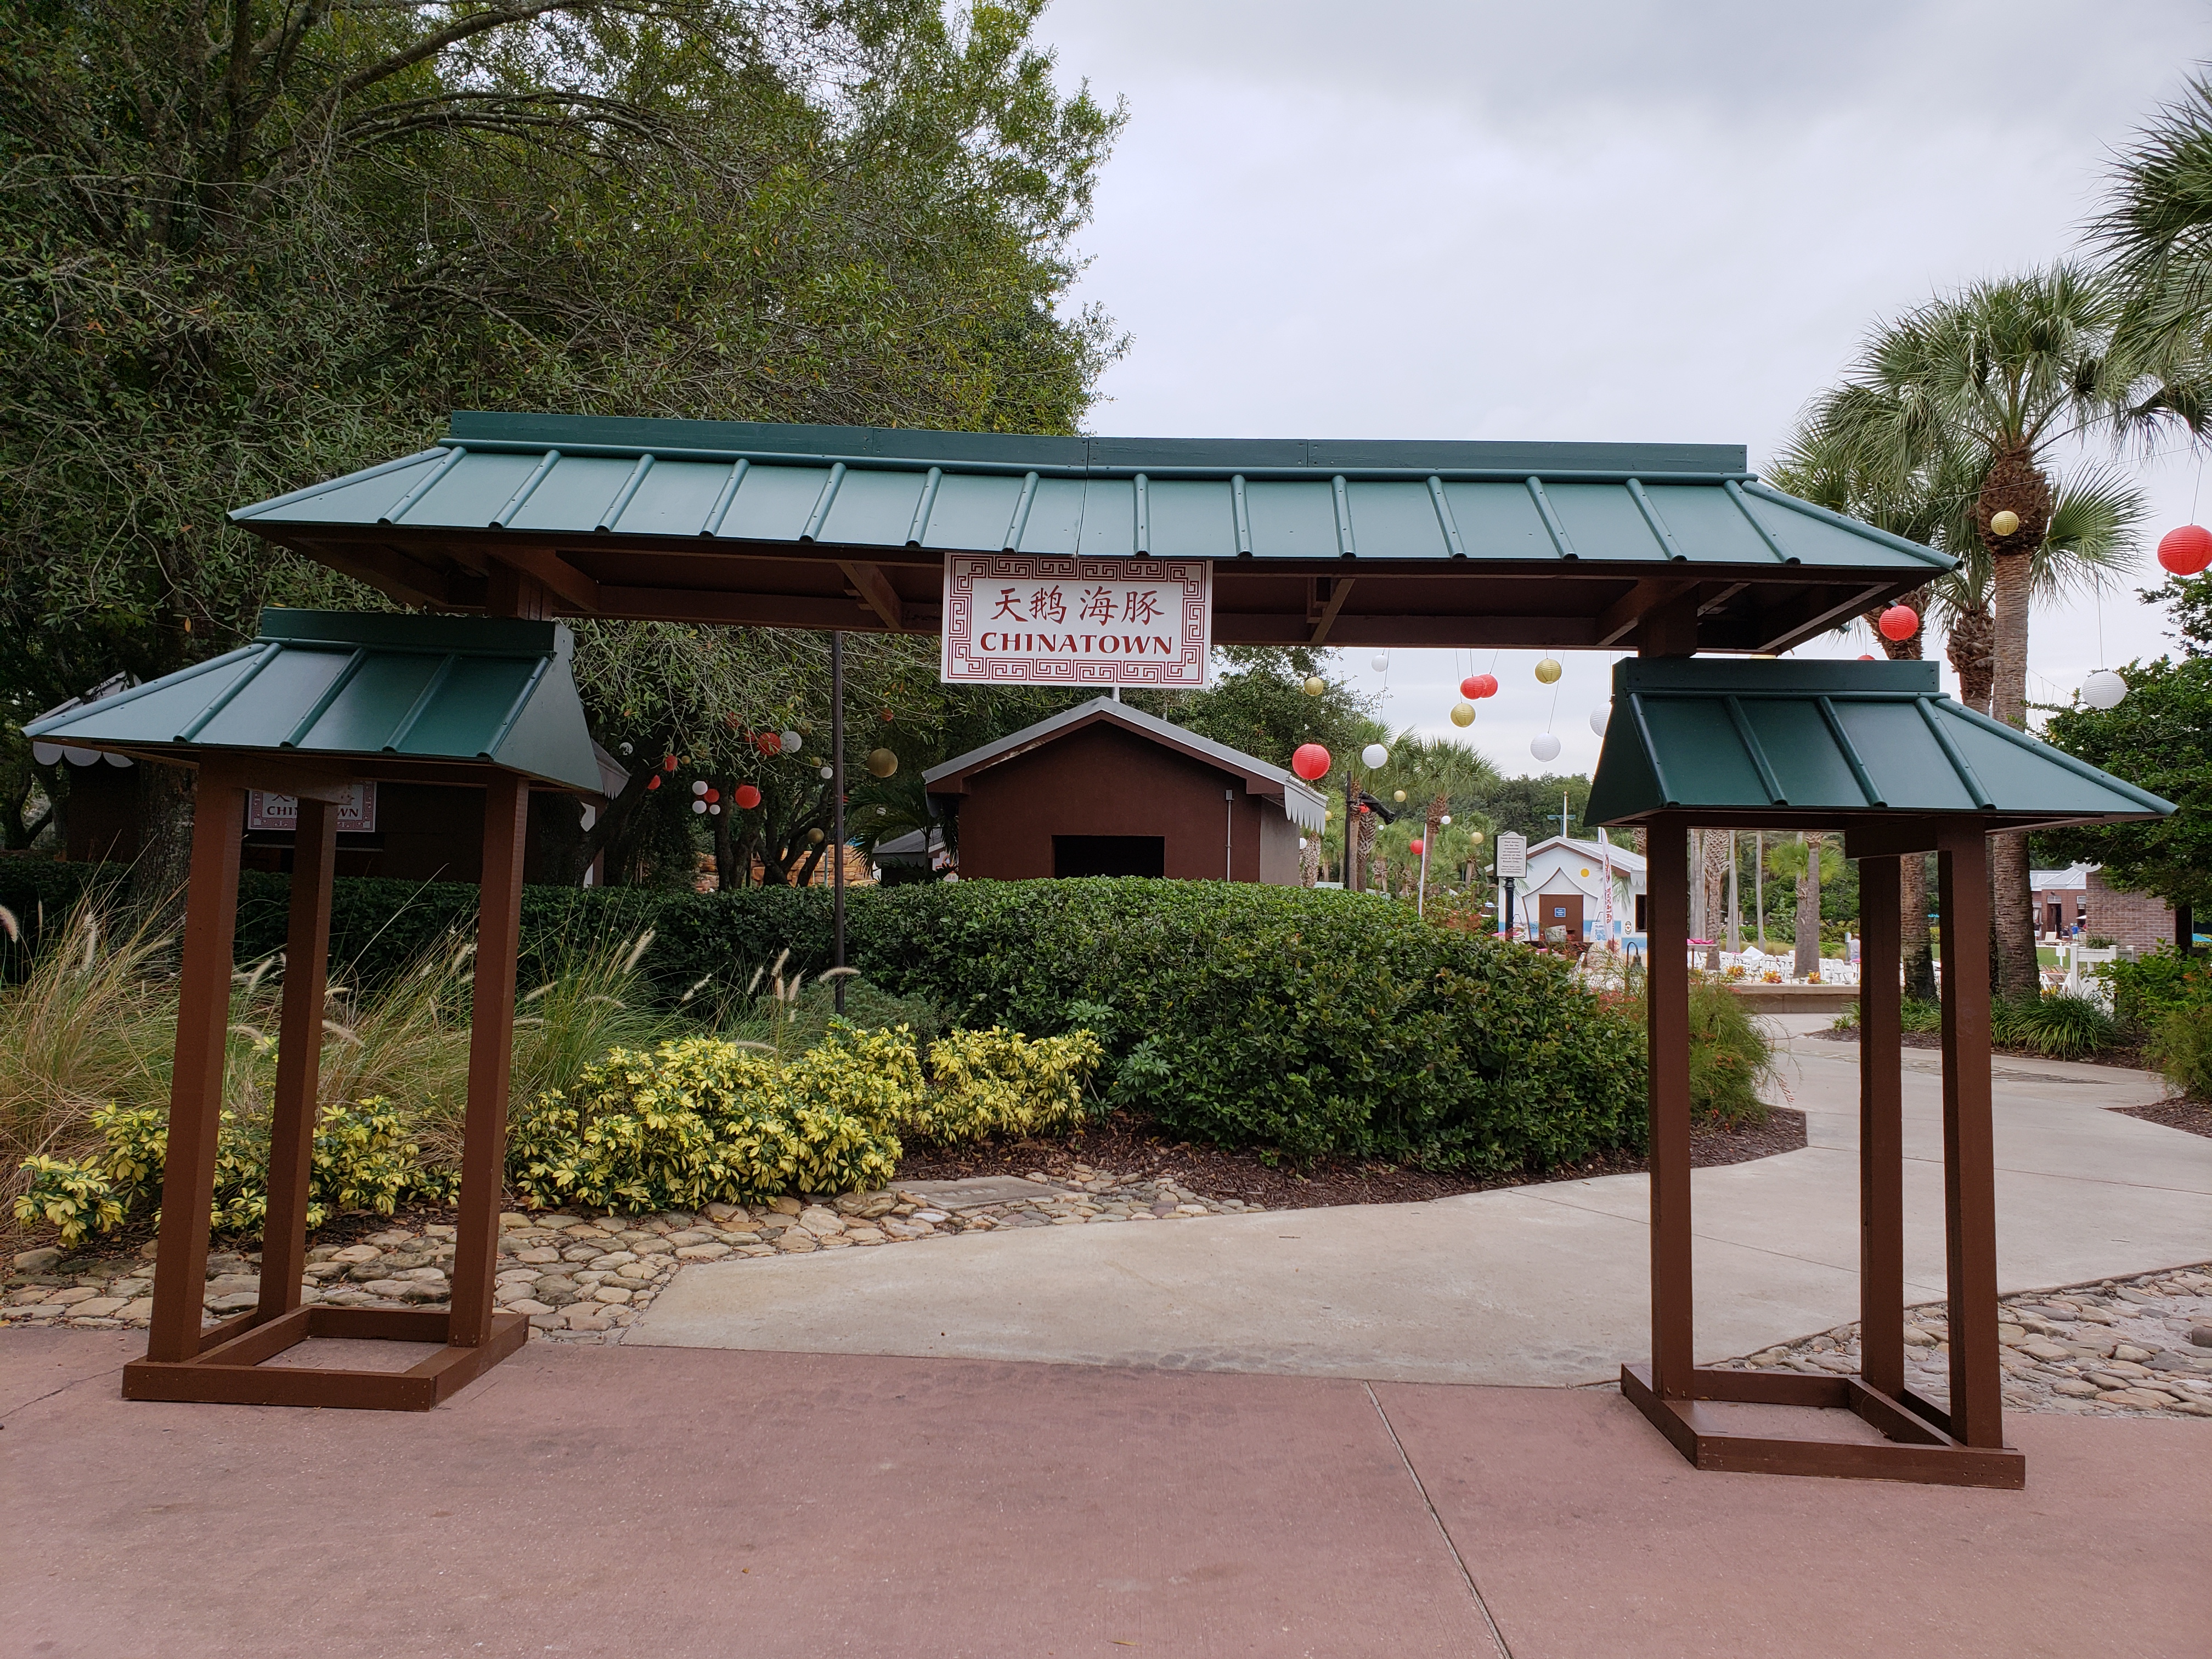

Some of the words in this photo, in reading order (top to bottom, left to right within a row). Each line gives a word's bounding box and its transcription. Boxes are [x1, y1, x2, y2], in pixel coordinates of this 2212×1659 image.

[990, 585, 1165, 626] 天鹅海豚
[980, 632, 1172, 655] CHINATOWN
